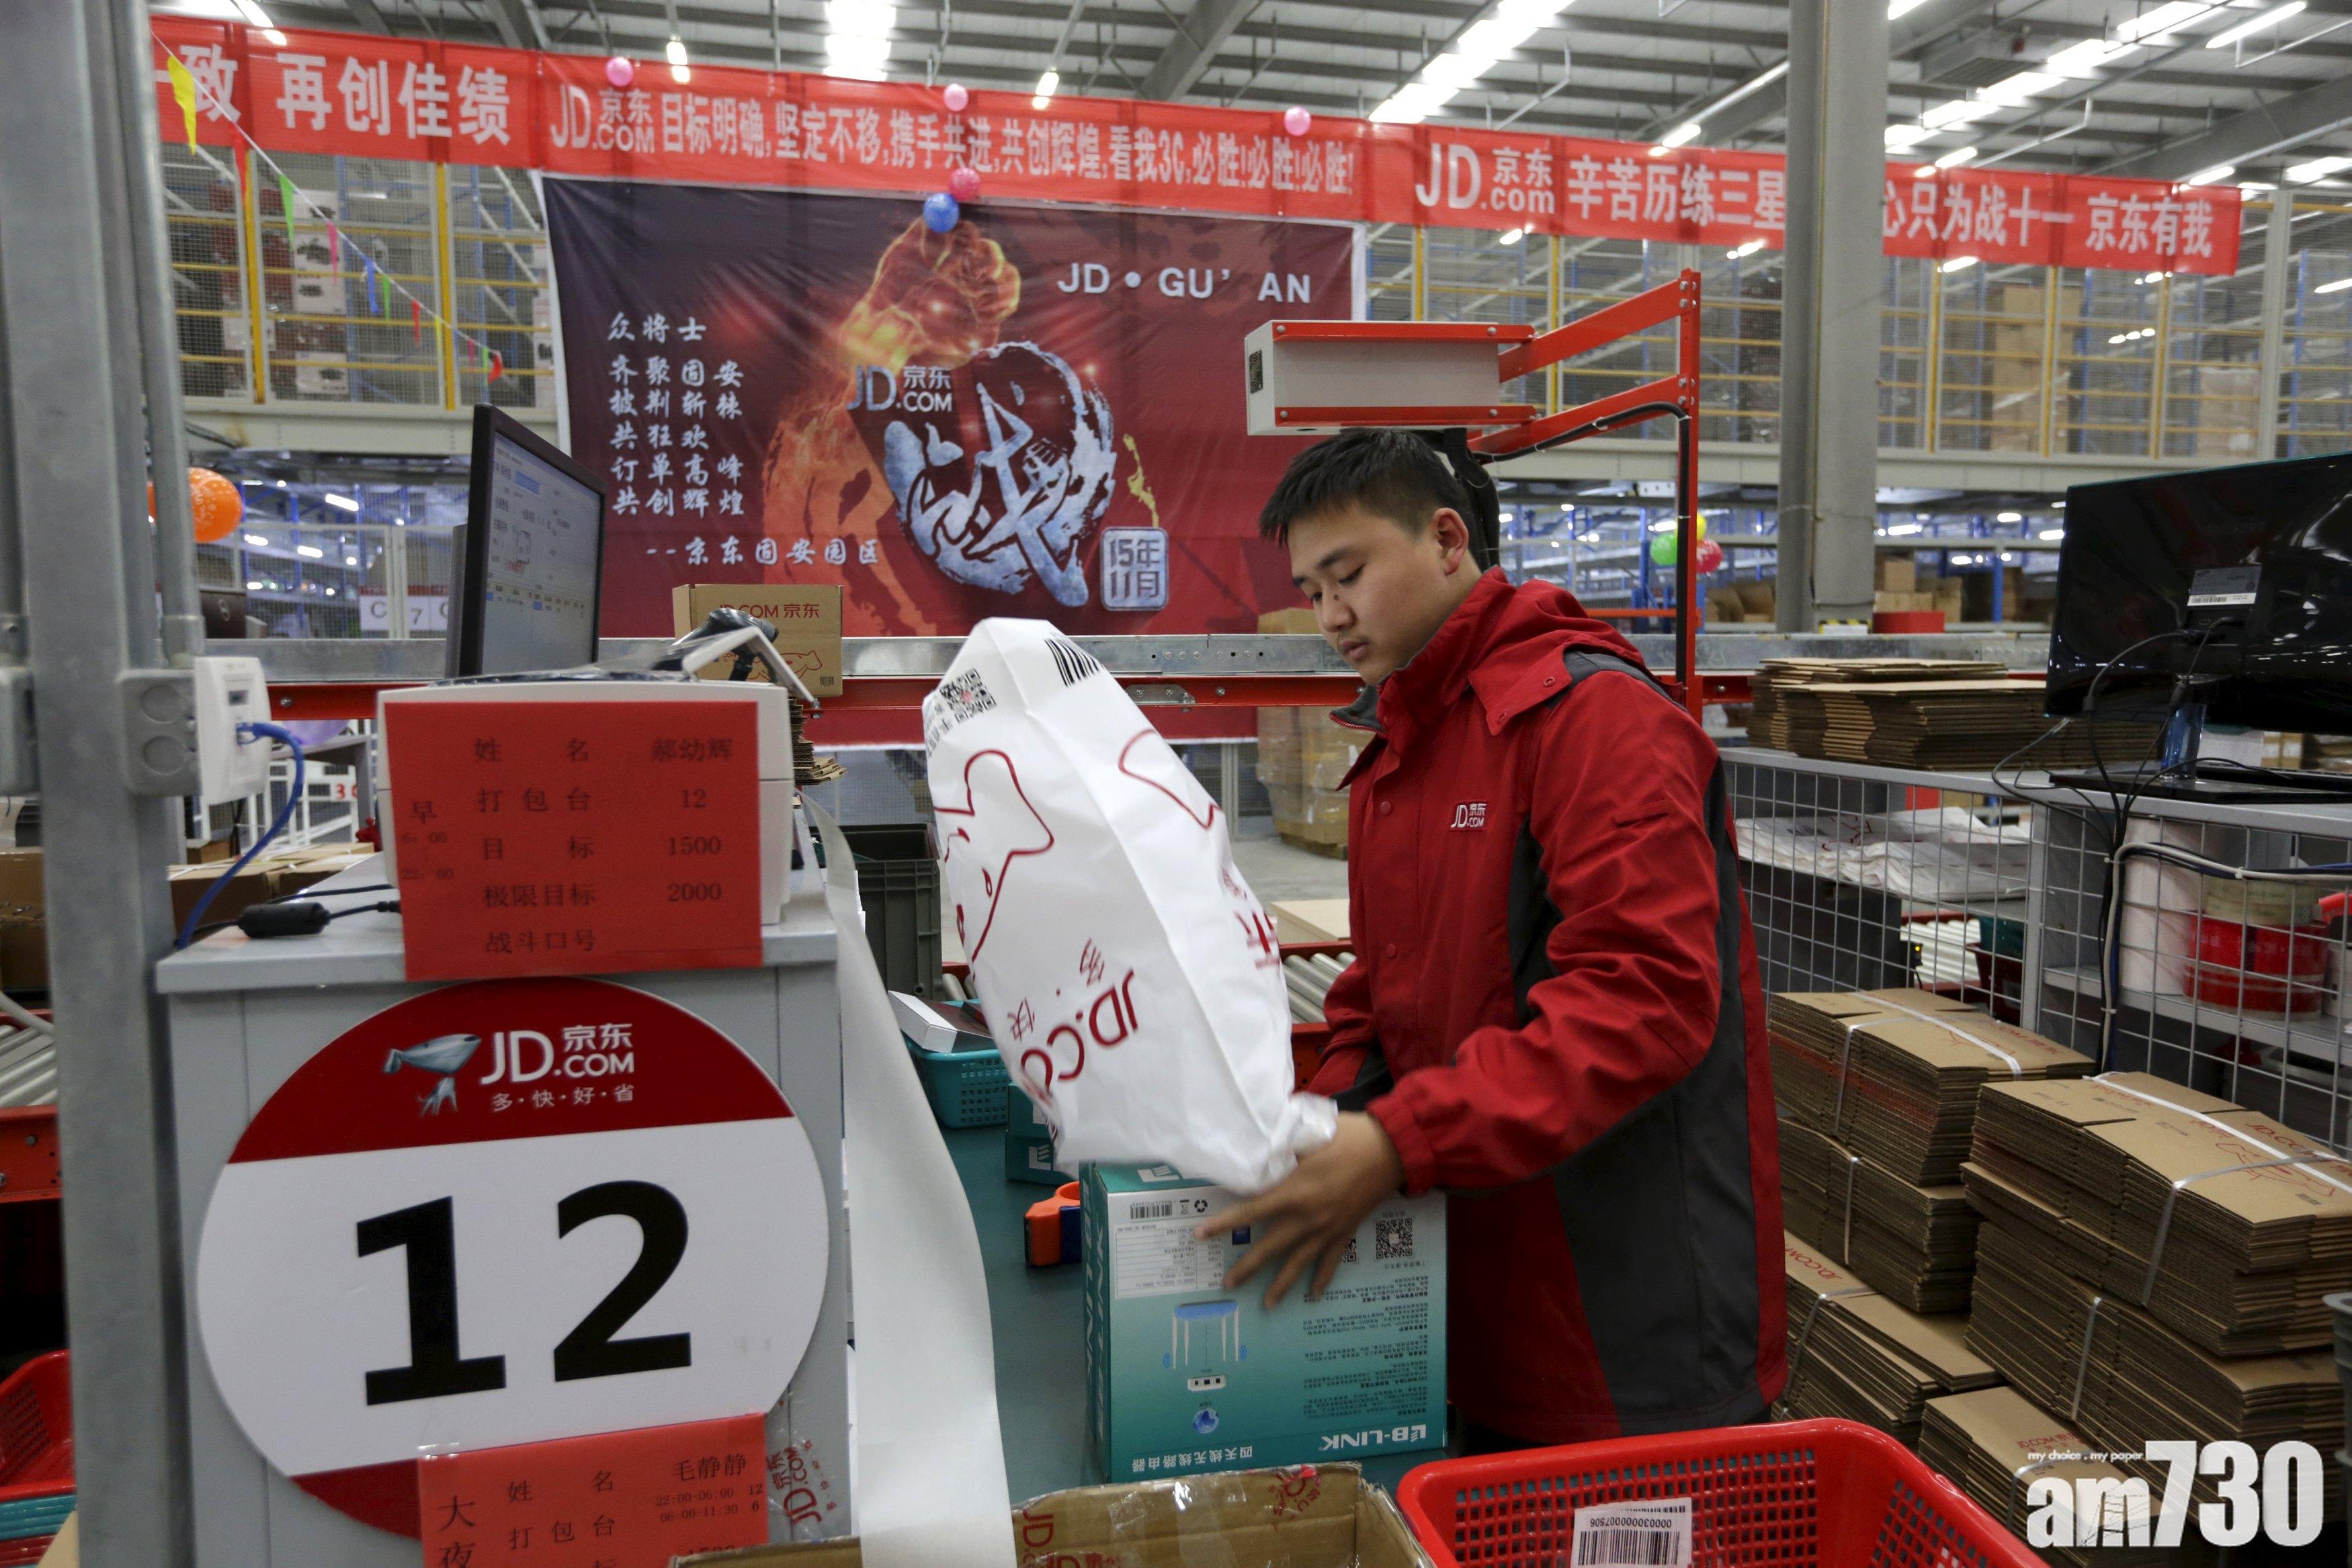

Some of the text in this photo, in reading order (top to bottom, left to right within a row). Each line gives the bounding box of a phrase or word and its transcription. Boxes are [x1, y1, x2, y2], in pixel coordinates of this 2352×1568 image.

[276, 52, 511, 146] 再创佳绩
[599, 89, 653, 124] 京东
[1492, 146, 1554, 187] 京东
[2086, 191, 2214, 258] 京东有我
[1057, 263, 1110, 294] JD
[1257, 273, 1311, 304] AN
[609, 355, 744, 388] 齐聚固安
[902, 365, 952, 390] 京东
[612, 486, 745, 518] 共创辉煌
[784, 604, 820, 619] 京东
[412, 801, 437, 826] 早
[681, 789, 708, 809] 12
[1469, 803, 1487, 816] 京东
[668, 836, 721, 856] 1500
[483, 883, 722, 908] 极限目标 2000
[487, 930, 597, 954] 战斗口号
[562, 1022, 633, 1053] 京东
[479, 1030, 635, 1085] JD.COM
[355, 1179, 692, 1406] 12
[673, 1453, 747, 1482] 毛静静
[1132, 1444, 1253, 1473] 四天线无线路由器
[655, 1483, 763, 1507] 22:00-06:00 12
[751, 1500, 760, 1512] 6
